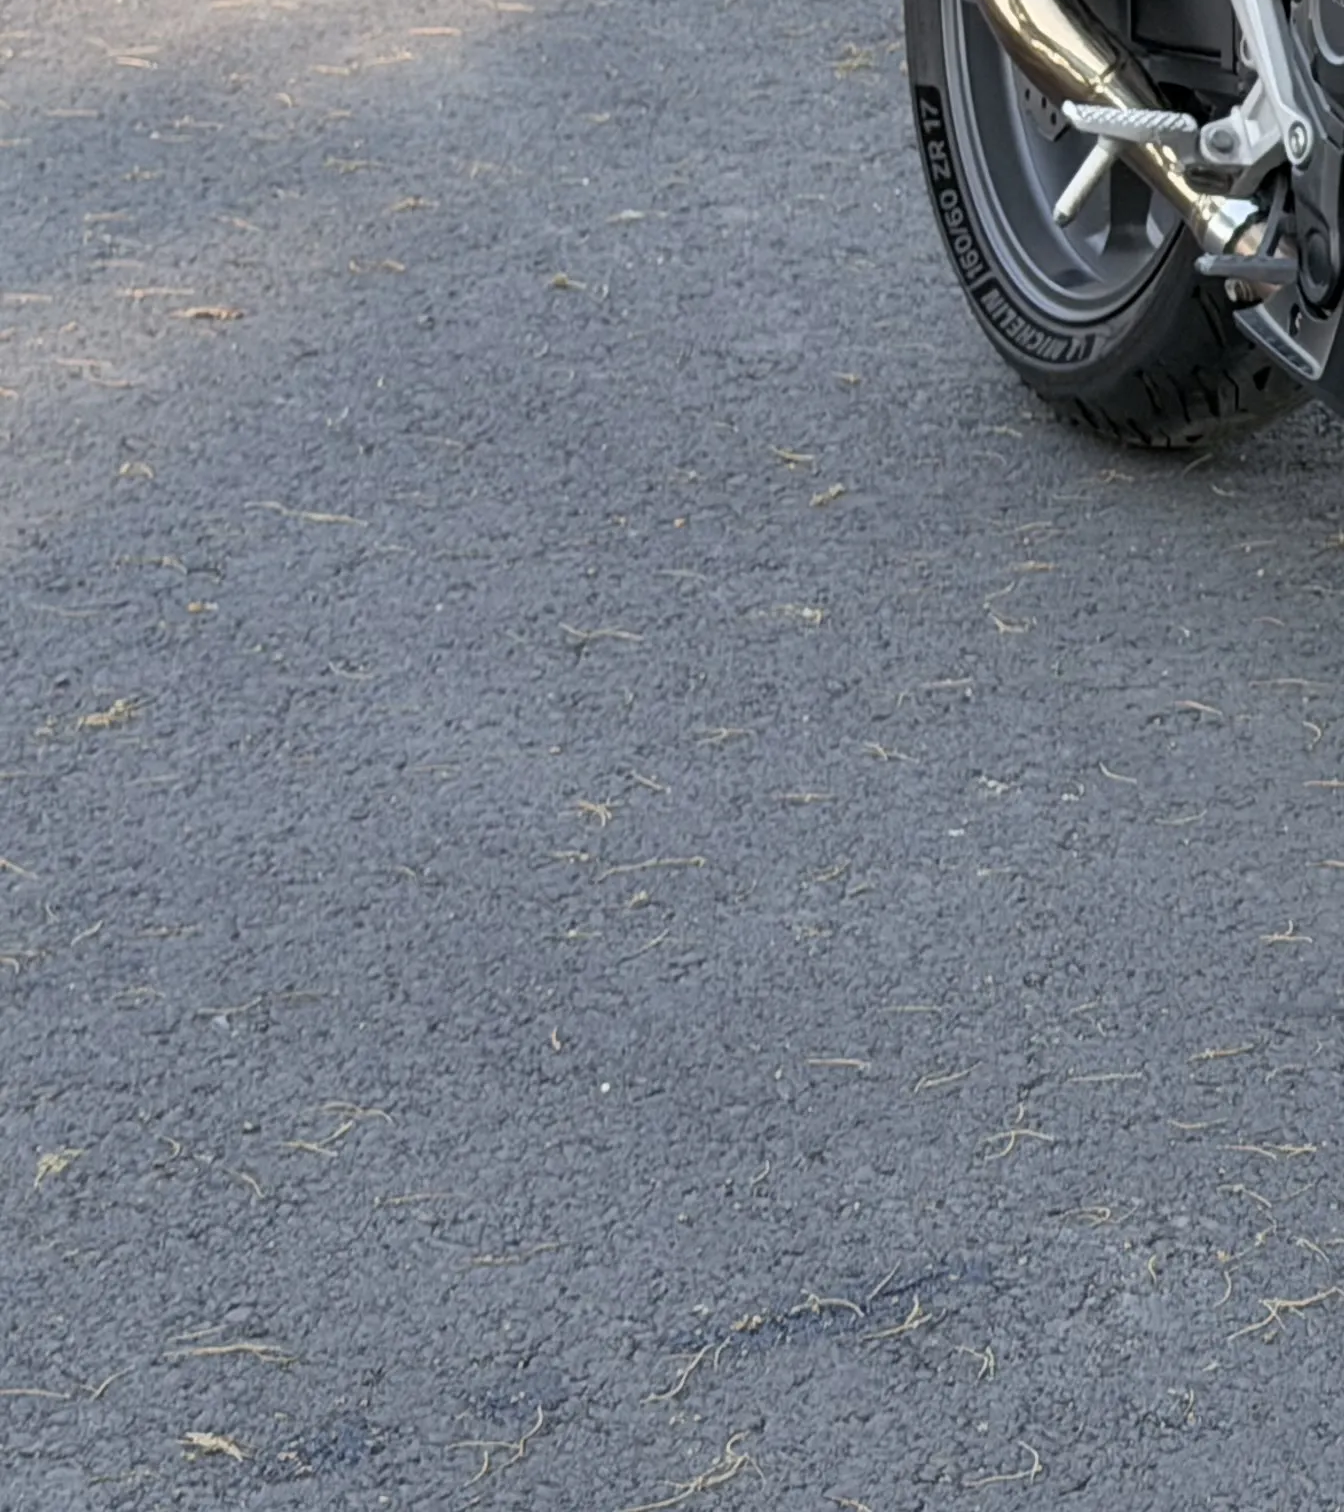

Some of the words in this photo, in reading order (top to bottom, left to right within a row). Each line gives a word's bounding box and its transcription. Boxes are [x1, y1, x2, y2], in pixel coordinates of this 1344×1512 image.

[920, 97, 942, 135] 17
[927, 139, 952, 181] ZR
[939, 188, 986, 280] 160/60
